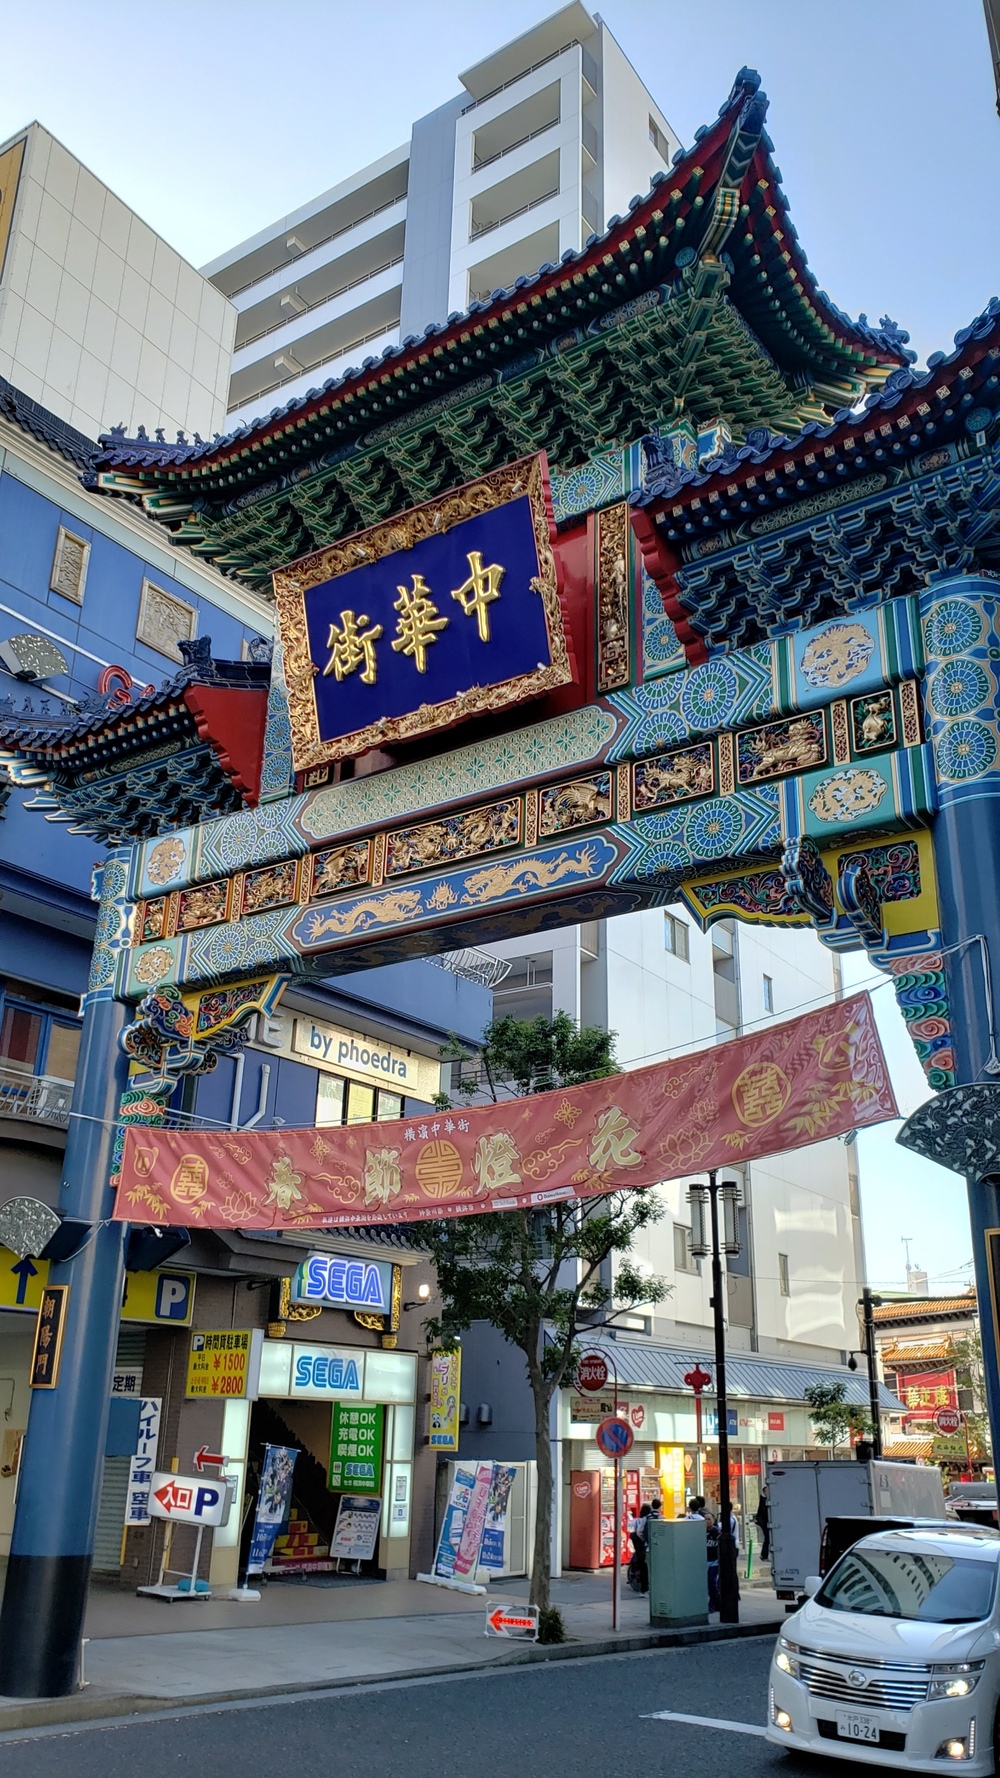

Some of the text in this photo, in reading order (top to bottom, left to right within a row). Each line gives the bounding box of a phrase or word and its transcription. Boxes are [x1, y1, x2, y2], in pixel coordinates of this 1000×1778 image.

[323, 551, 504, 685] 中華街
[310, 1025, 407, 1079] by phoedra
[307, 1256, 384, 1306] SEGA
[159, 1279, 187, 1317] P
[36, 1296, 56, 1375] 朝陽門
[193, 1334, 248, 1350] P 時間貸駐車場
[213, 1353, 245, 1371] ¥1500
[295, 1356, 359, 1390] SEGA
[580, 1366, 605, 1380] 消火栓
[113, 1376, 136, 1392] 定期
[211, 1376, 243, 1394] ¥2800
[340, 1412, 376, 1425] 休憩OK
[939, 1416, 958, 1427] 消火栓
[338, 1428, 375, 1441] 充電OK
[431, 1435, 454, 1445] SEGA
[337, 1444, 374, 1457] 喫煙OK
[345, 1463, 374, 1478] SEGA
[130, 1491, 149, 1521] 空車
[162, 1486, 191, 1508] 入口
[194, 1487, 219, 1517] P
[848, 1723, 877, 1739] 10-24
